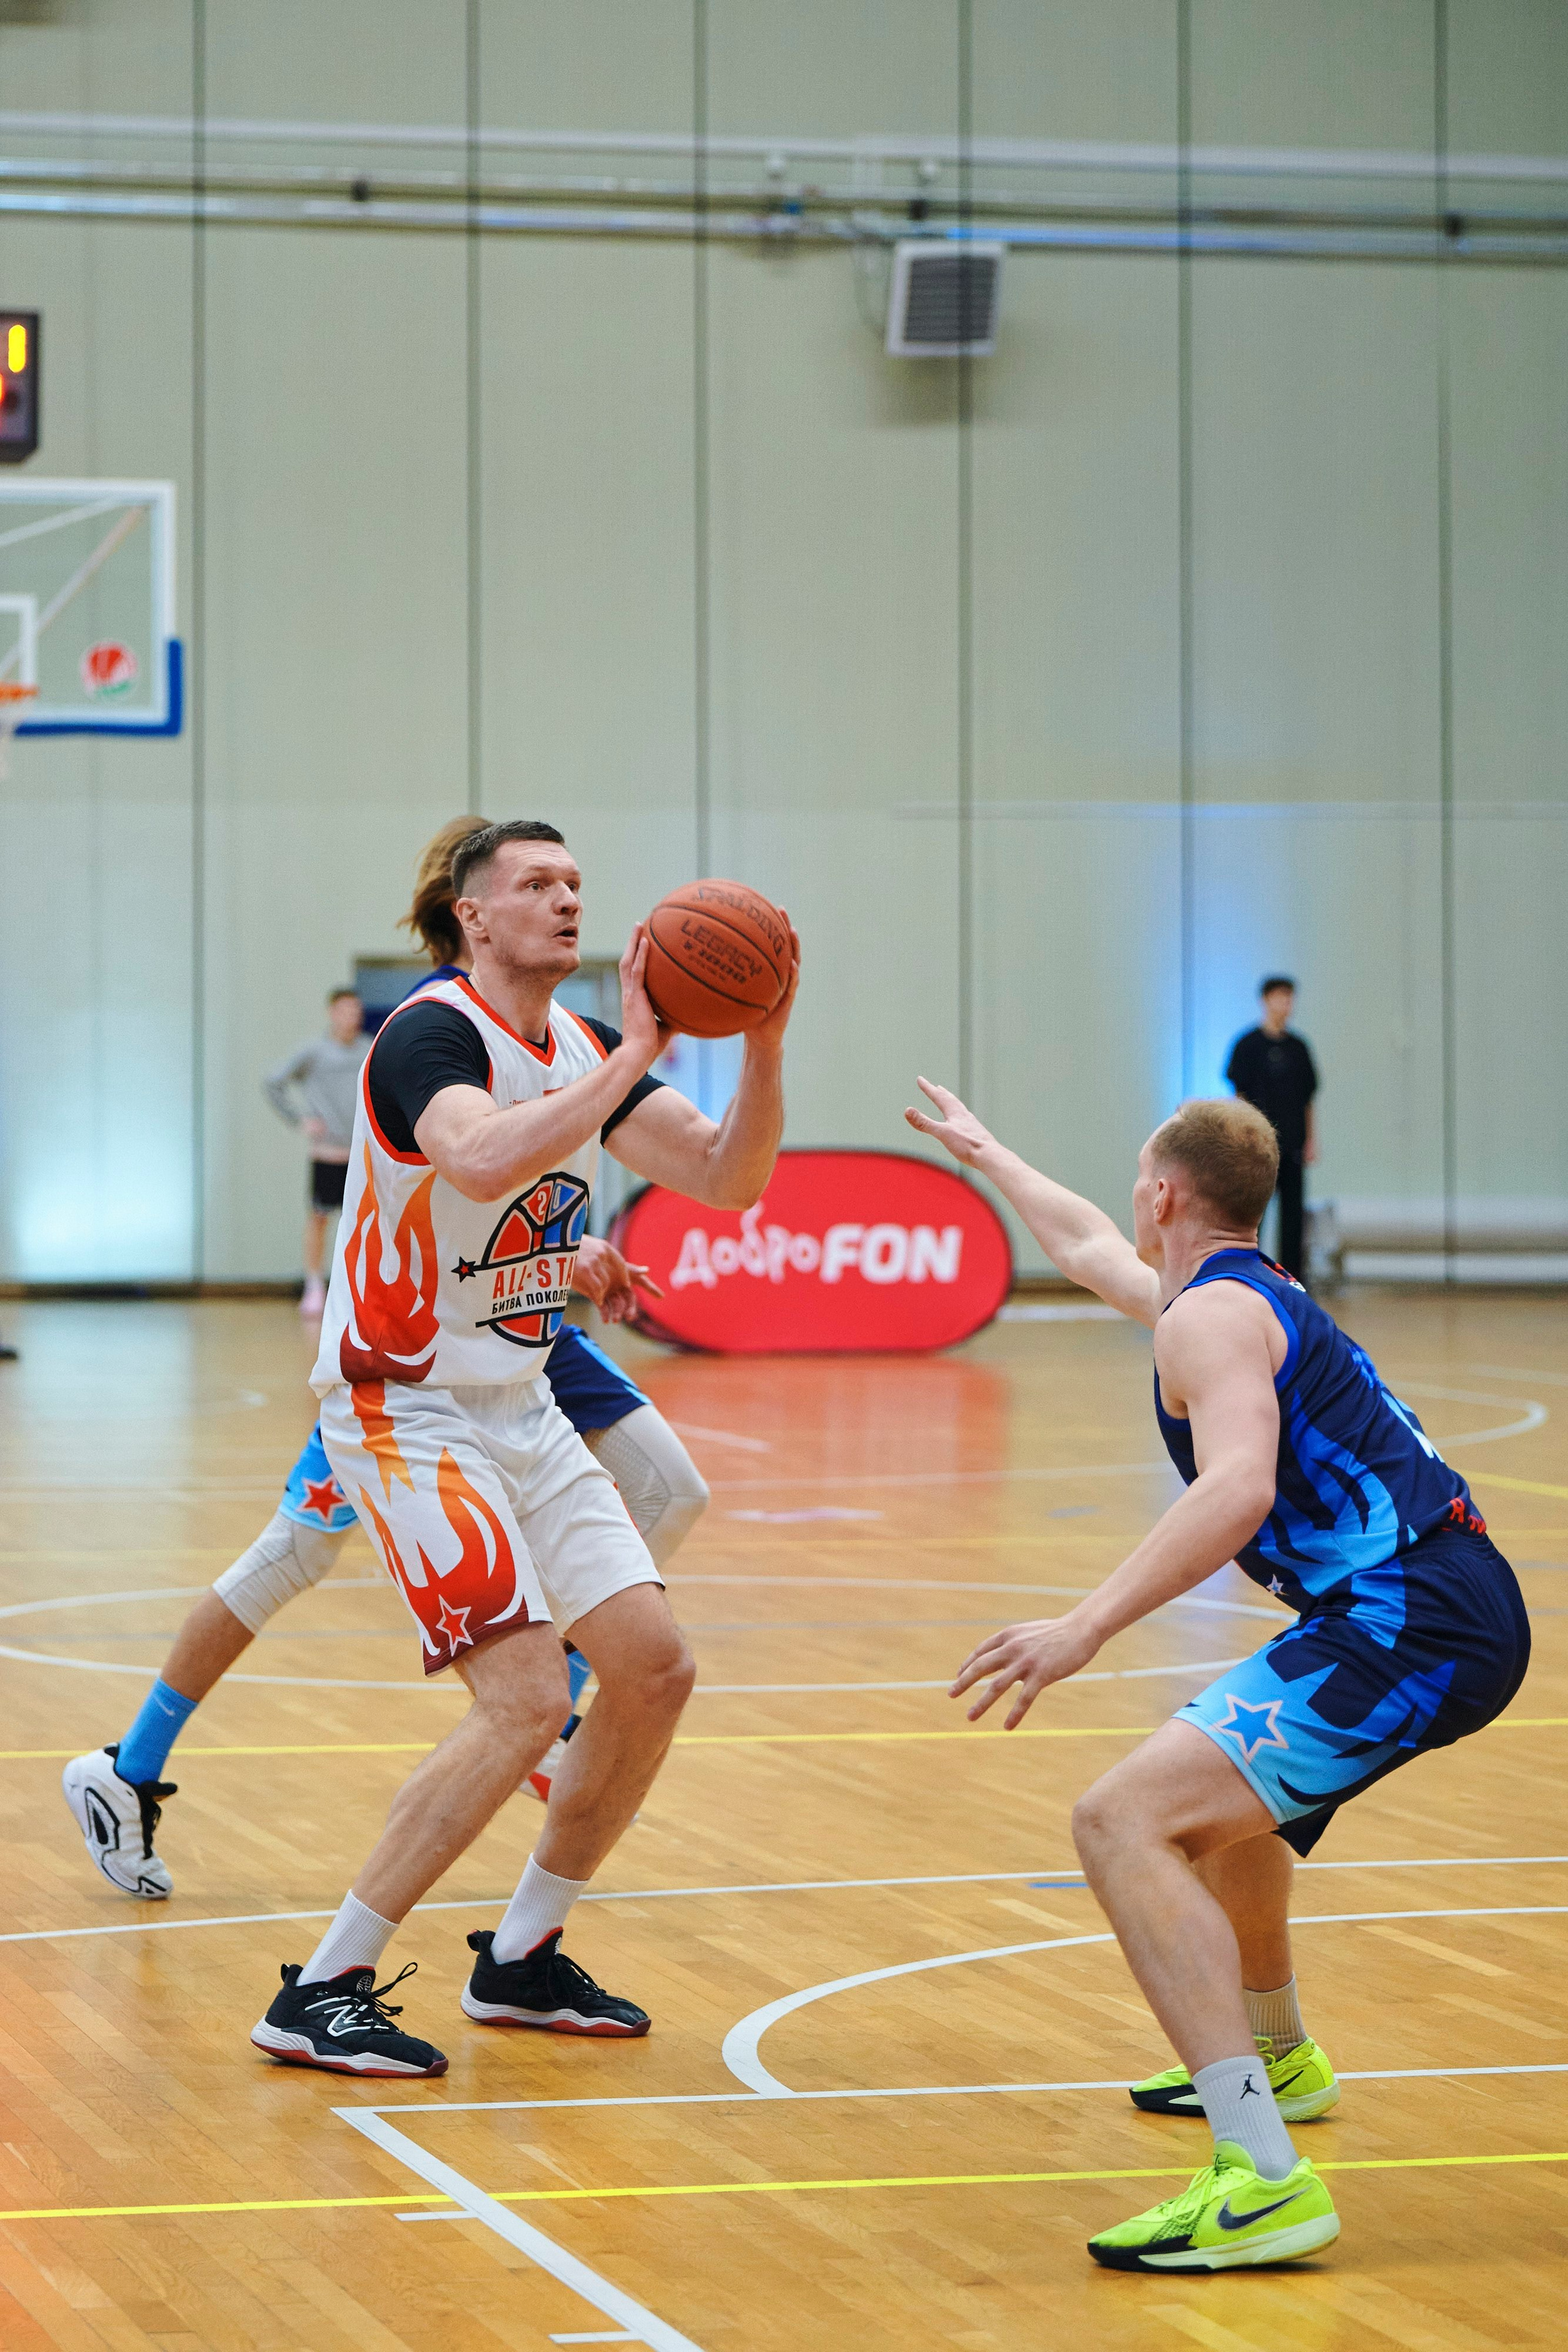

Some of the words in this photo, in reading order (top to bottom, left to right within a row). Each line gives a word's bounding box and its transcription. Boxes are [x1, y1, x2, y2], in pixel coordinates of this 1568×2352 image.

[681, 919, 763, 977] LEGACY
[492, 1255, 578, 1299] ALL-STA
[492, 1295, 522, 1314] БИТВА
